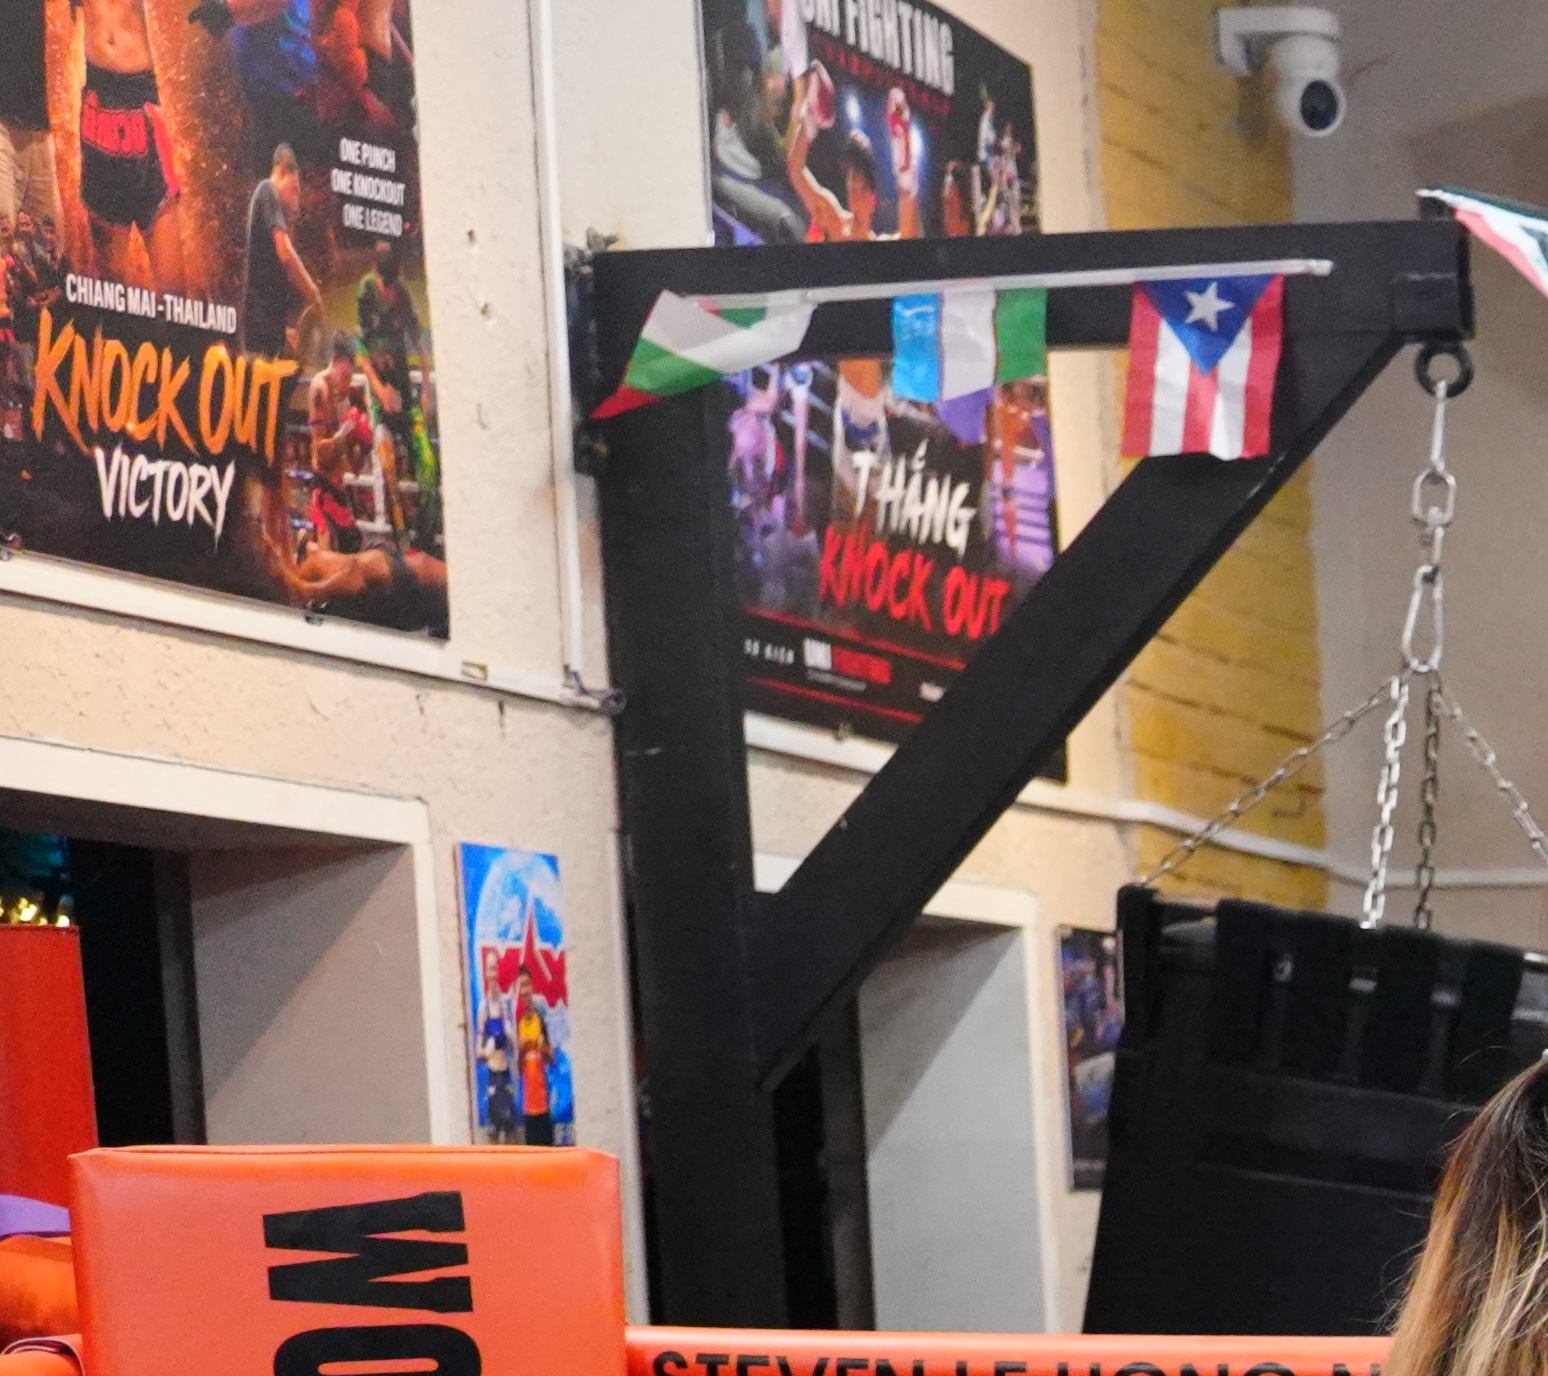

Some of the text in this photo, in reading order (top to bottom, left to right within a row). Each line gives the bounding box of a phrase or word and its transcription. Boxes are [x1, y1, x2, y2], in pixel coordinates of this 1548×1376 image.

[363, 143, 396, 173] PUNCH
[331, 170, 405, 206] ONE KNOCKOUT
[343, 203, 364, 228] ONE
[65, 272, 125, 312] CHIANG
[32, 304, 299, 466] KNOCK OUT
[95, 443, 236, 551] VICTORY
[818, 522, 1012, 641] KNOCK OUT
